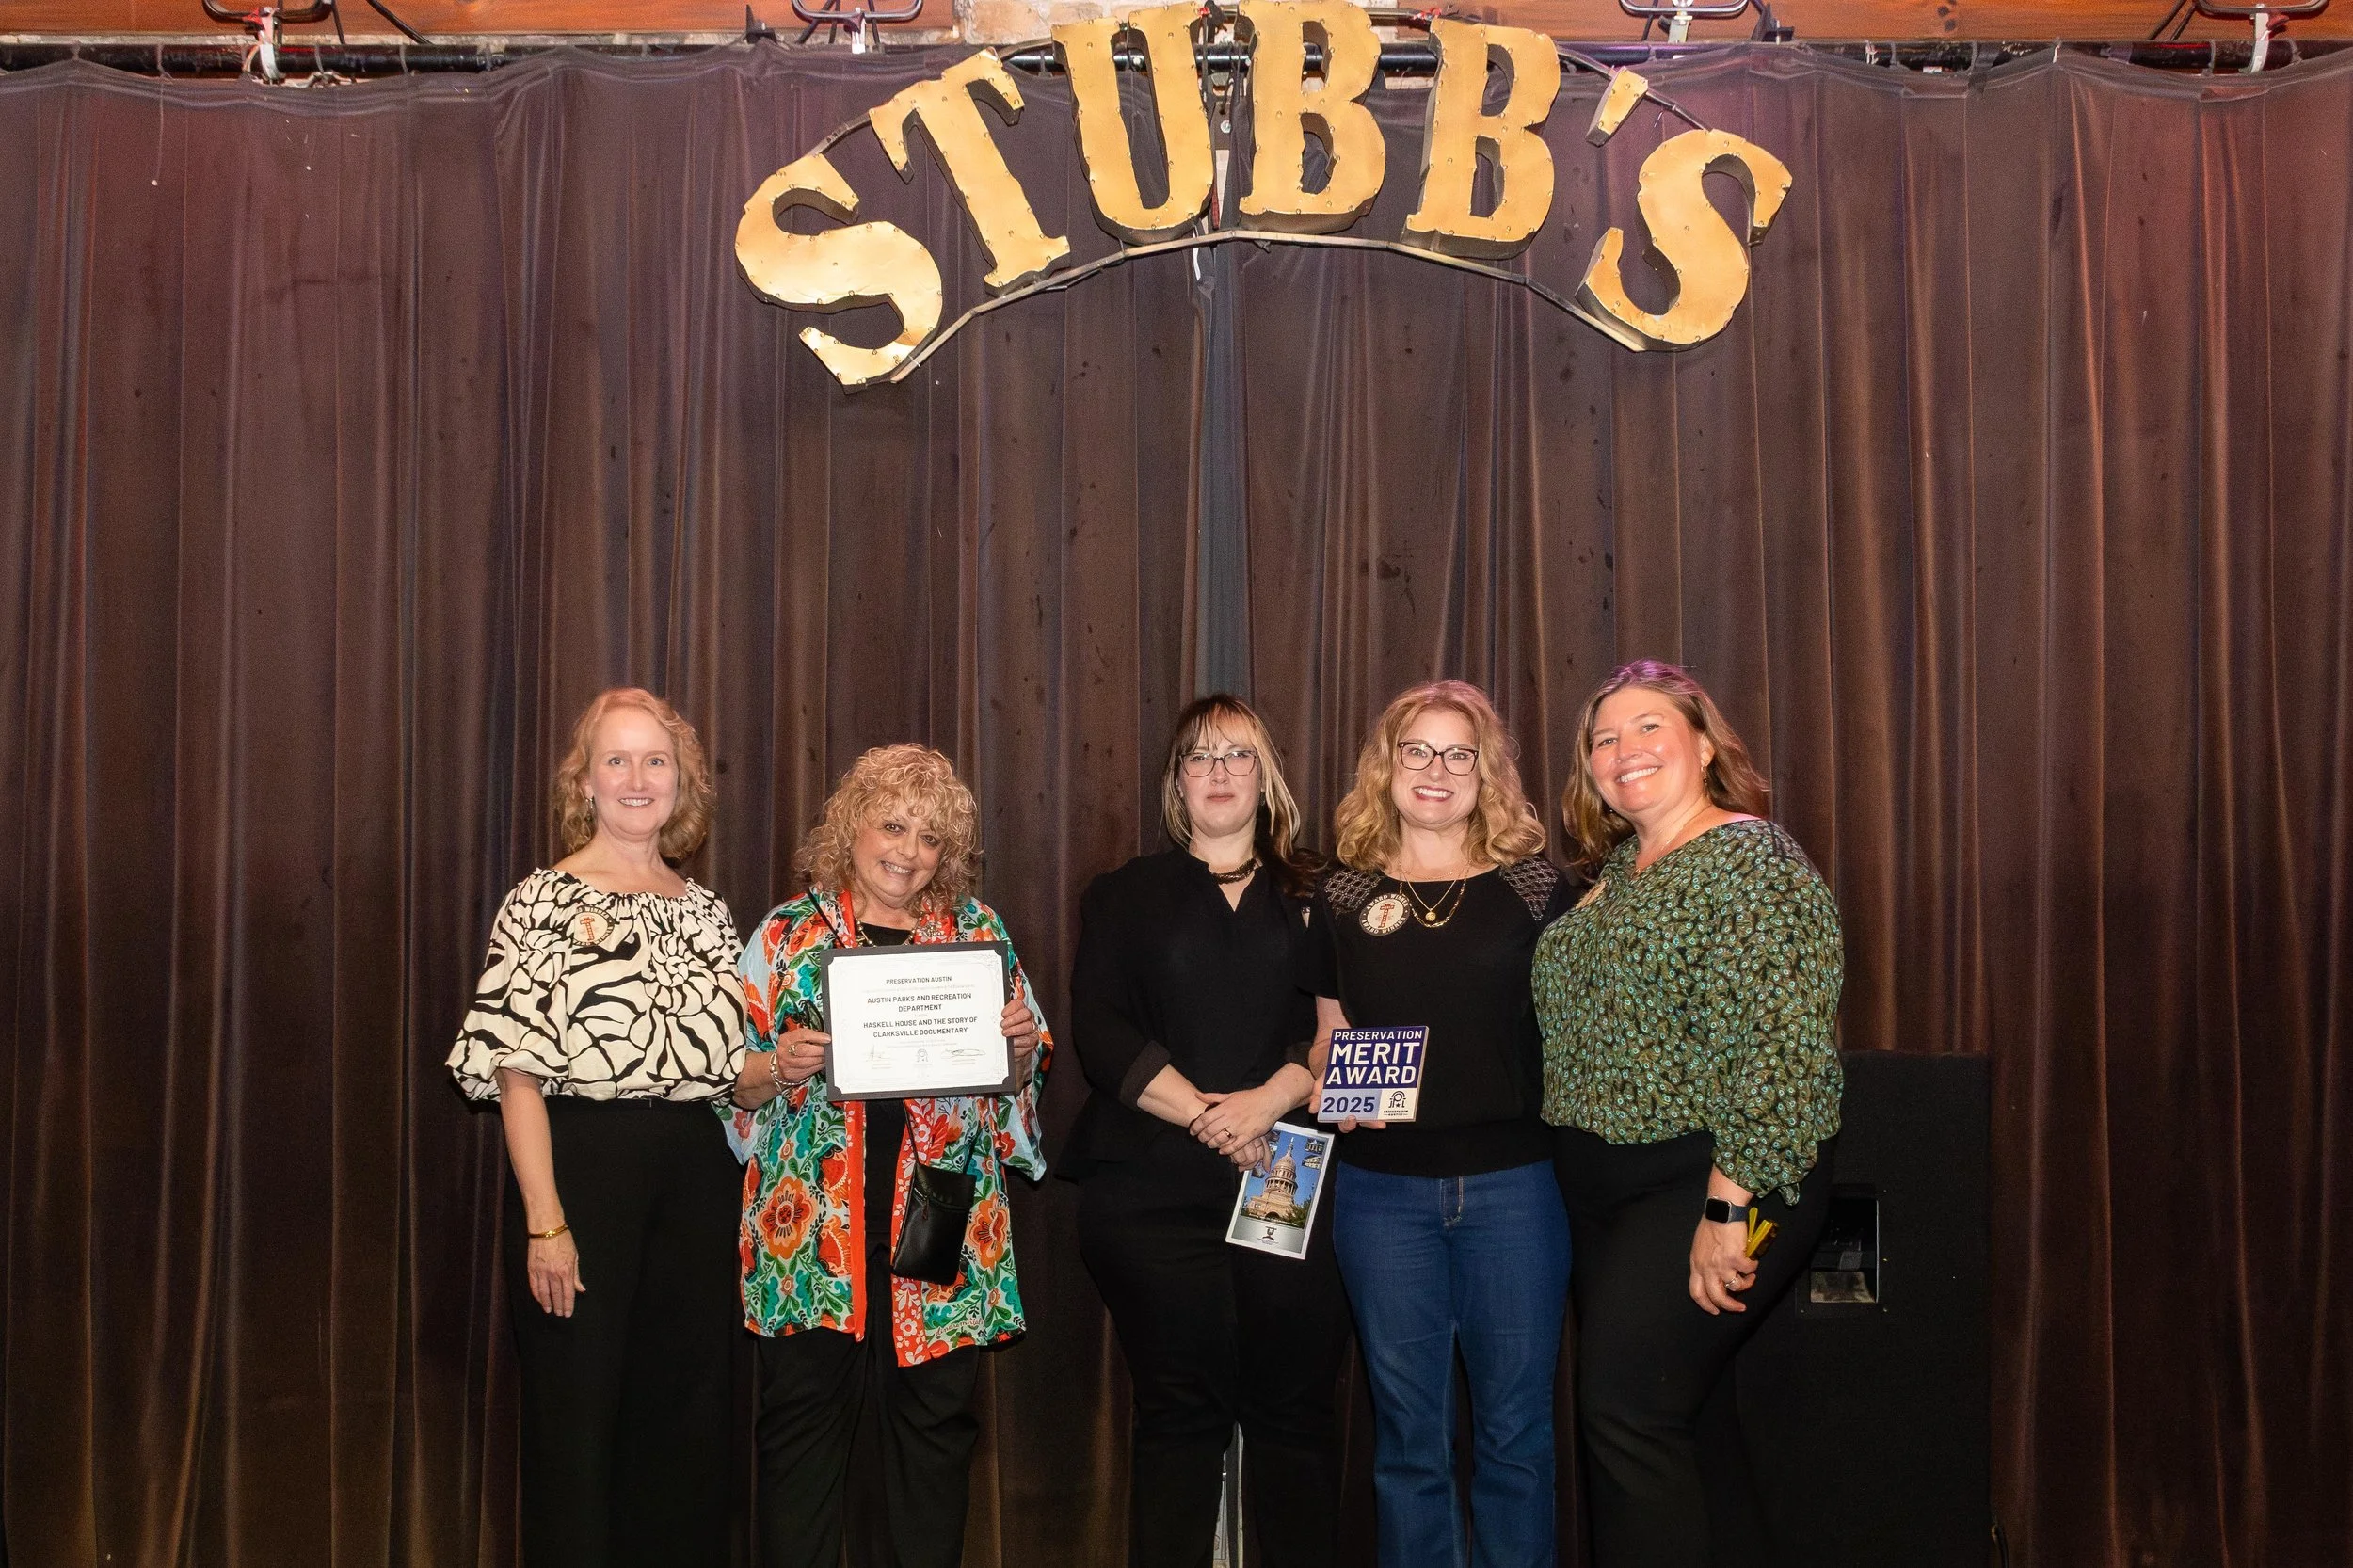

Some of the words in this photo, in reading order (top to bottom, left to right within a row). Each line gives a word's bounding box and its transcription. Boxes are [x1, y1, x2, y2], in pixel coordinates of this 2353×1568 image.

[735, 0, 1794, 388] STUBB'S
[1366, 894, 1388, 910] AWARD
[893, 995, 915, 1003] PARKS
[898, 1003, 942, 1013] DEPARTMENT
[863, 1020, 894, 1029] HASKELL
[872, 1030, 919, 1038] CLARKSVILLE
[919, 1027, 968, 1036] DOCUMENTARY
[1334, 1030, 1422, 1041] PRESERVATION
[1330, 1042, 1420, 1065] MERIT
[1325, 1065, 1417, 1085] AWARD
[1321, 1096, 1376, 1113] 2025
